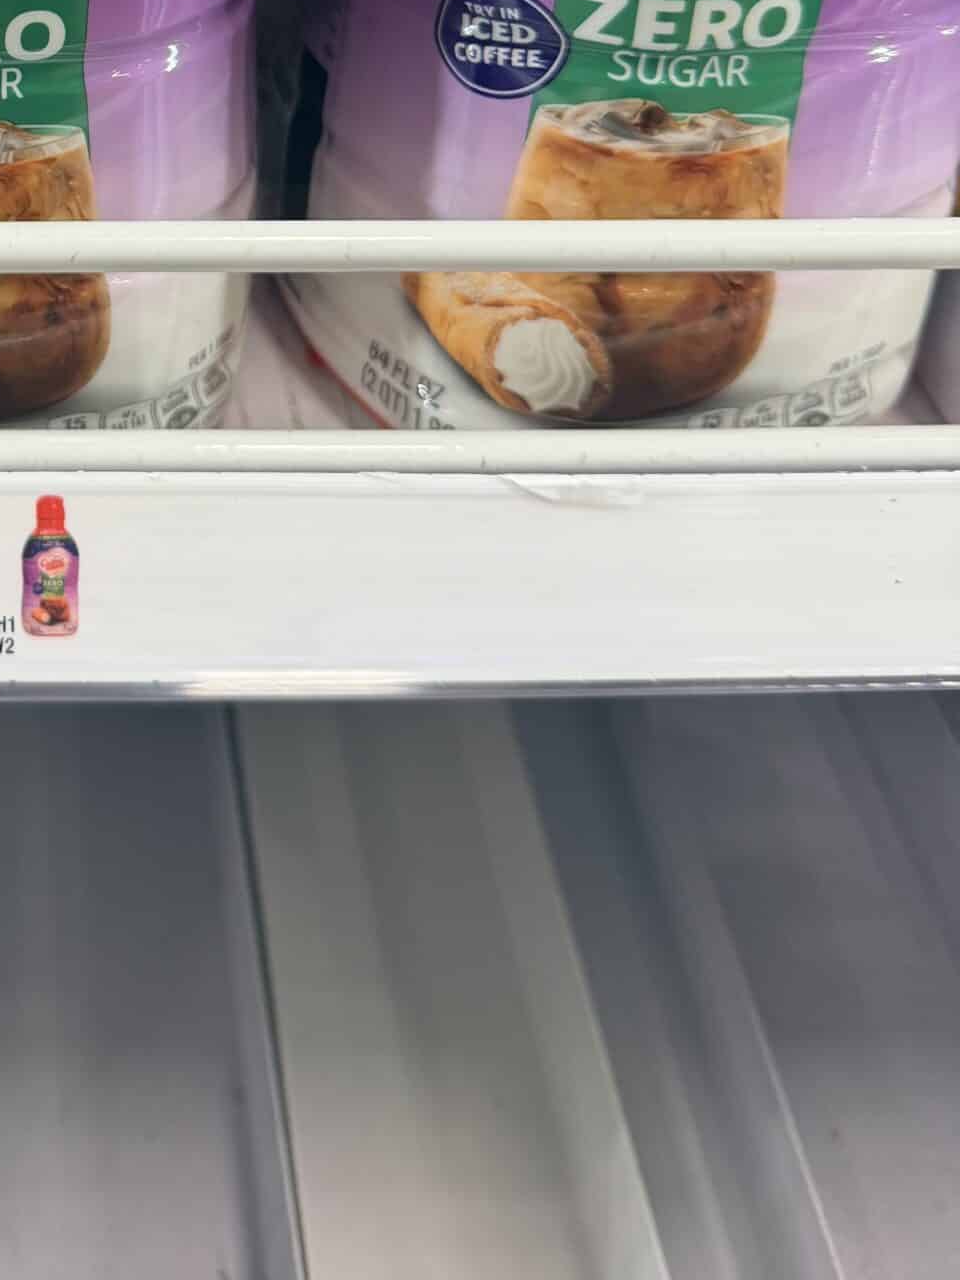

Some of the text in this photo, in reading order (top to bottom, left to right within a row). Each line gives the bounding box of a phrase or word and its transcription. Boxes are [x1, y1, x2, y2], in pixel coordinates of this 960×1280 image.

[464, 2, 520, 20] TRY IN
[460, 13, 538, 44] ICED
[454, 42, 545, 69] COFFEE
[607, 49, 752, 88] SUGAR
